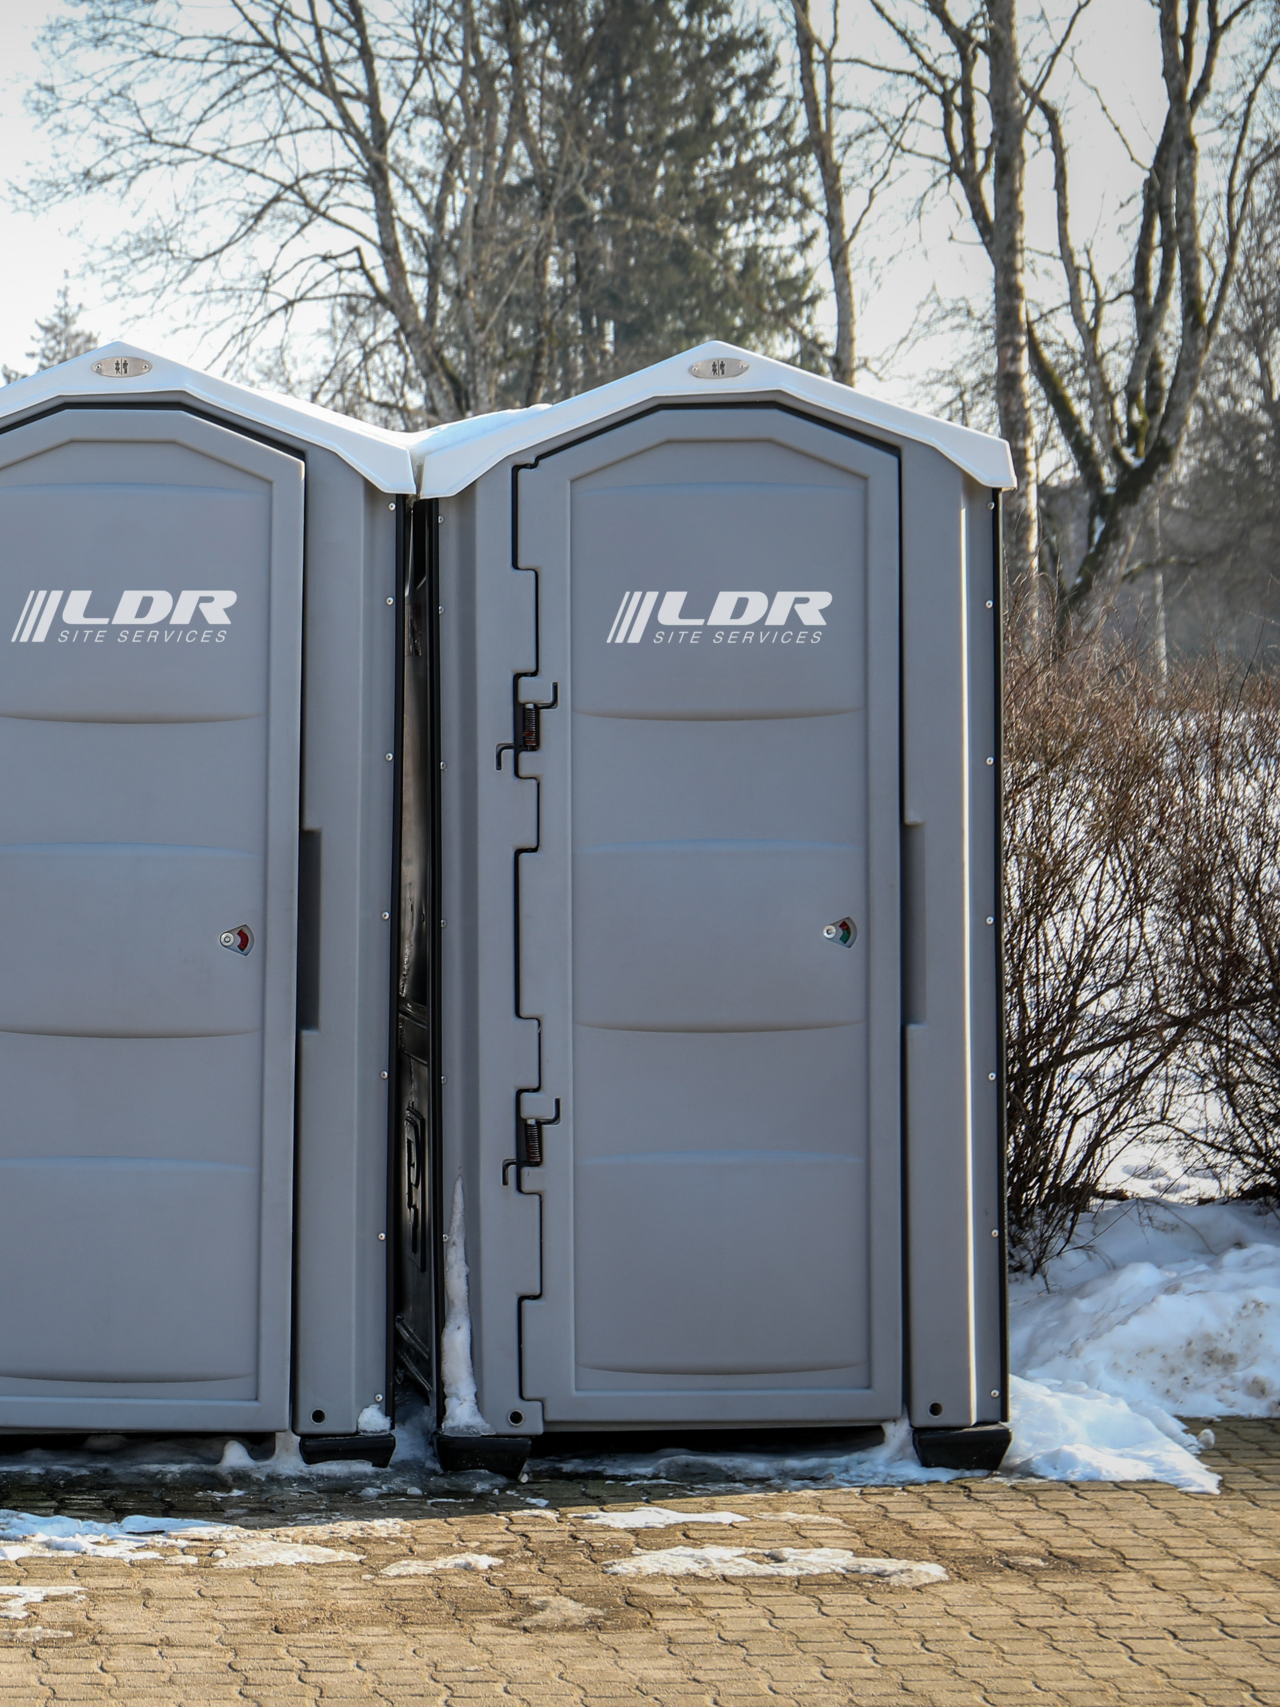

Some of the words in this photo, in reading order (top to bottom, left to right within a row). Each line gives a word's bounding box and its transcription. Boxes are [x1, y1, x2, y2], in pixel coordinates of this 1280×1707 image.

[62, 590, 237, 624] LDR
[657, 591, 833, 625] LDR
[57, 630, 107, 643] SITE
[117, 630, 227, 643] SERVICES
[653, 631, 703, 644] SITE
[712, 631, 822, 644] SERVICES
